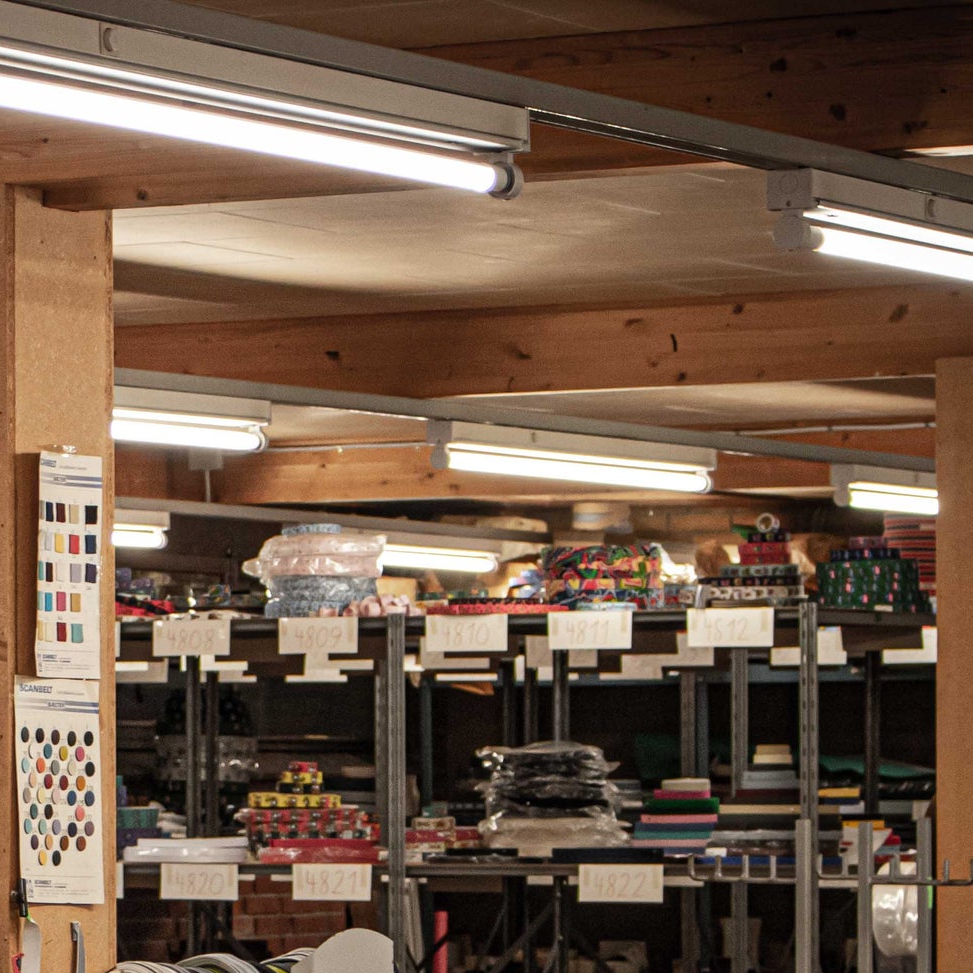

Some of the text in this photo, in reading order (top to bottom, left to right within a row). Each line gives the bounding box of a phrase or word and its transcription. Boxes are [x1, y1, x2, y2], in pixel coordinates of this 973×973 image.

[166, 628, 215, 651] 4808
[295, 625, 342, 649] 4809
[442, 621, 490, 646] 4810
[566, 619, 609, 645] 4811
[176, 871, 224, 895] 4820
[305, 870, 357, 894] 4821
[594, 871, 646, 898] 4822
